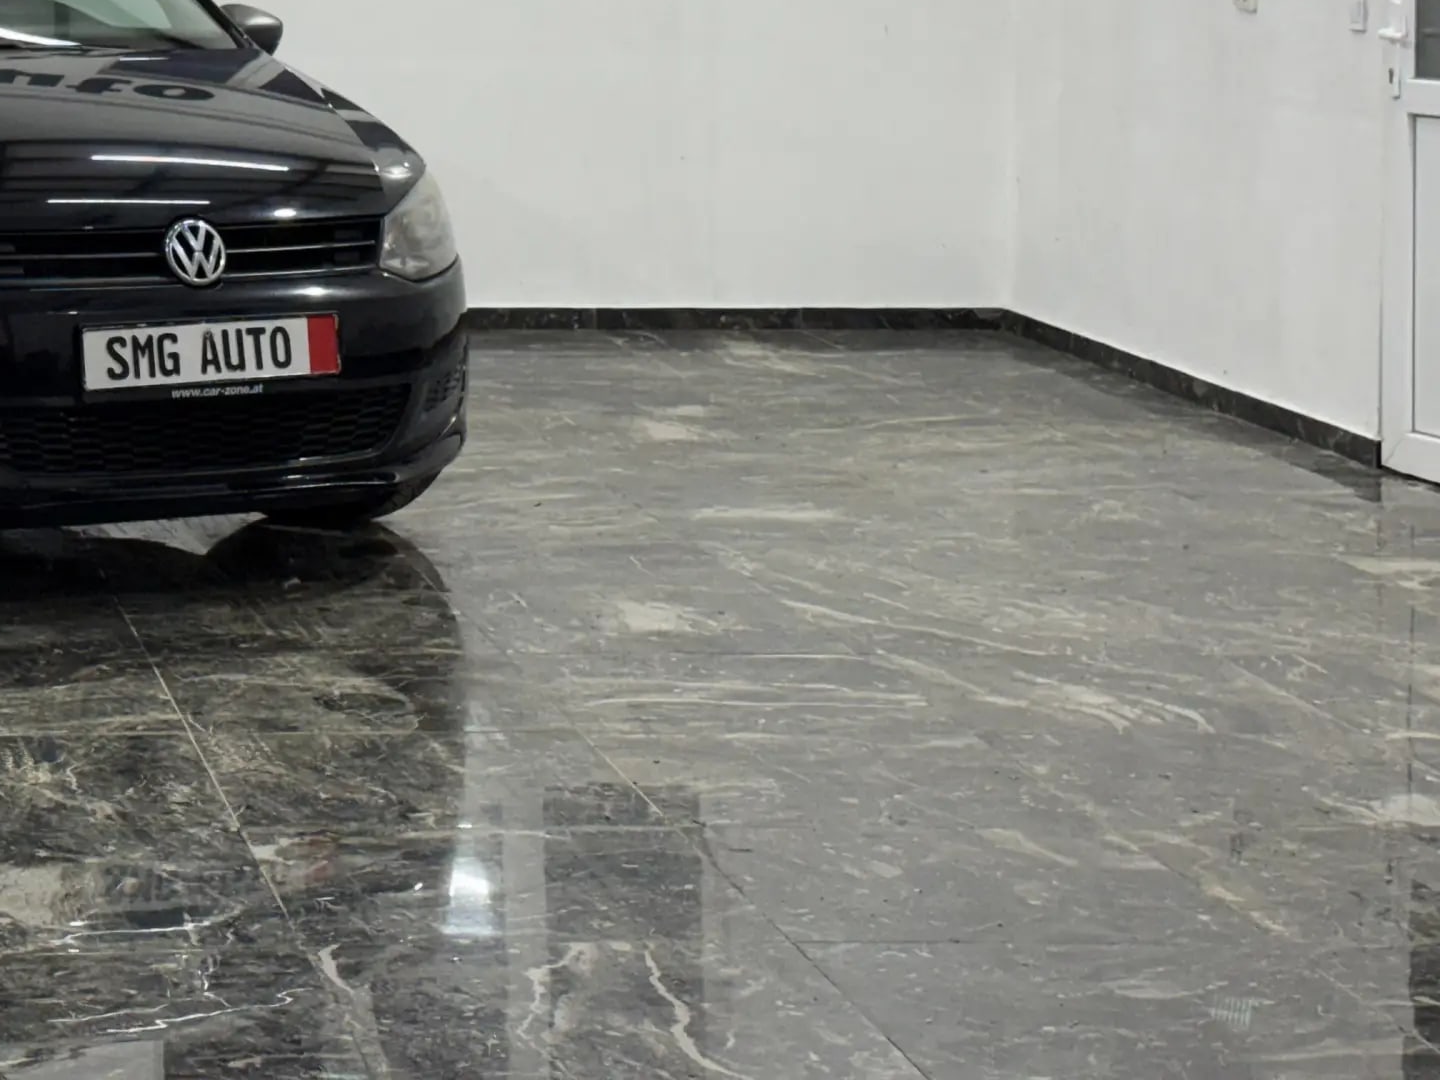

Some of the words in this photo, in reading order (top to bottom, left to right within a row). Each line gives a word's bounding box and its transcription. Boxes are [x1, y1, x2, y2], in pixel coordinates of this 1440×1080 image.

[106, 333, 181, 381] SMG
[200, 325, 293, 375] AUTO
[171, 383, 264, 399] www.car-zone.at
